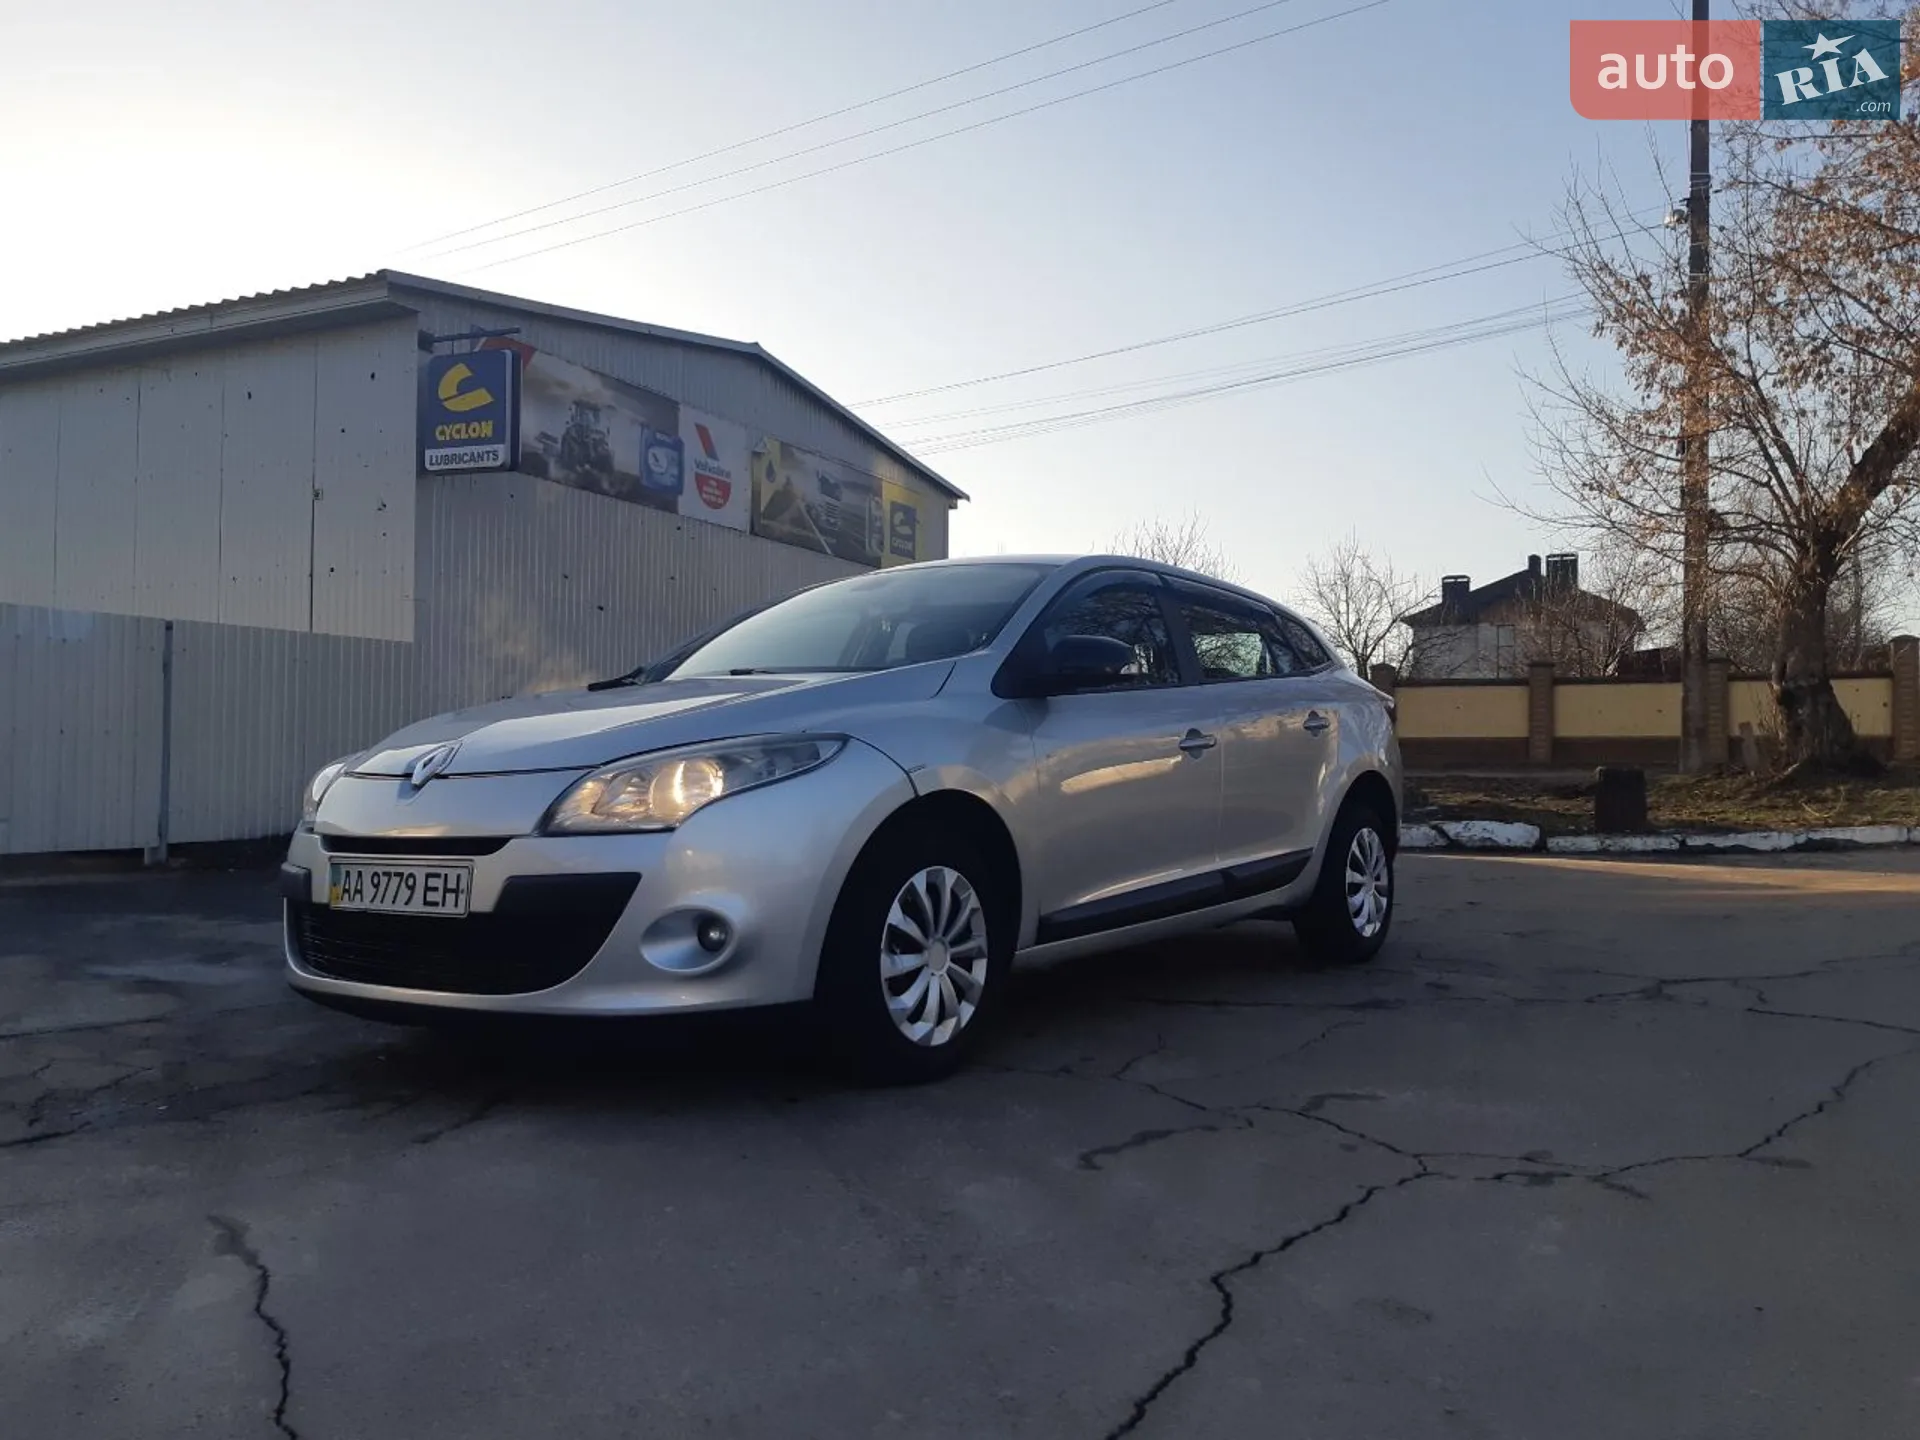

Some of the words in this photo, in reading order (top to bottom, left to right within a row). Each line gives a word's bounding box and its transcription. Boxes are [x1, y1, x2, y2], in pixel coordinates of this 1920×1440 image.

[435, 420, 494, 441] CYCLON
[429, 450, 500, 467] LUBRICANTS
[341, 870, 364, 903] AA
[369, 871, 417, 906] 9779
[423, 873, 461, 908] EH
